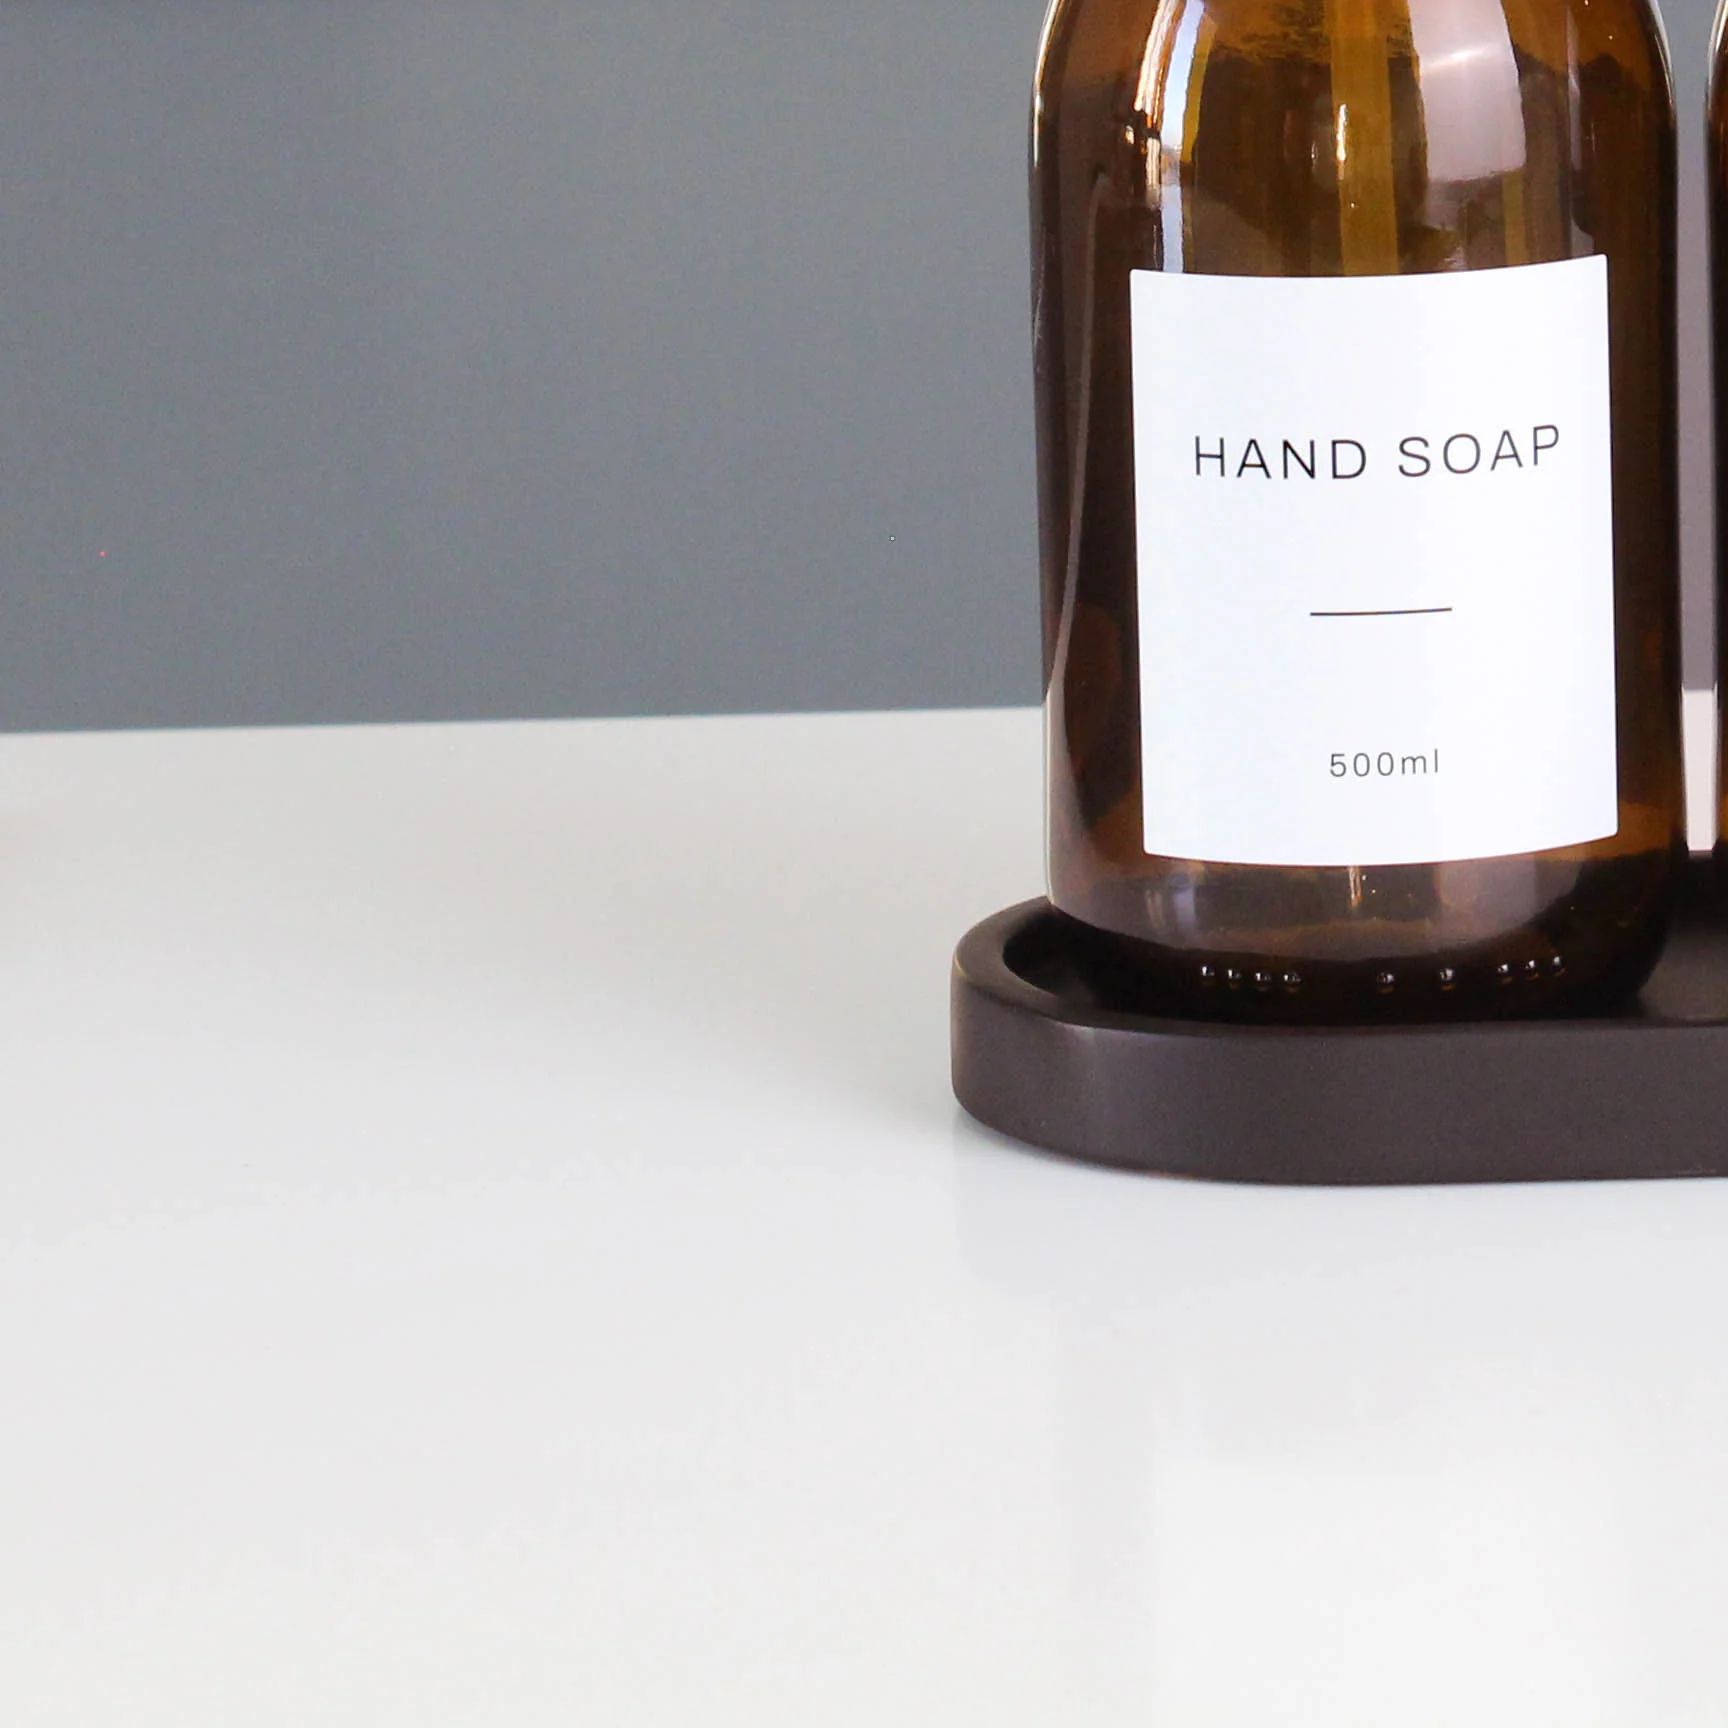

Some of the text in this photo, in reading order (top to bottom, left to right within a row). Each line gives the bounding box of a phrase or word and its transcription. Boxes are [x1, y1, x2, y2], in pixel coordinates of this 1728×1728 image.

[1194, 424, 1560, 480] HAND SOAP
[1329, 749, 1439, 778] 500ml
